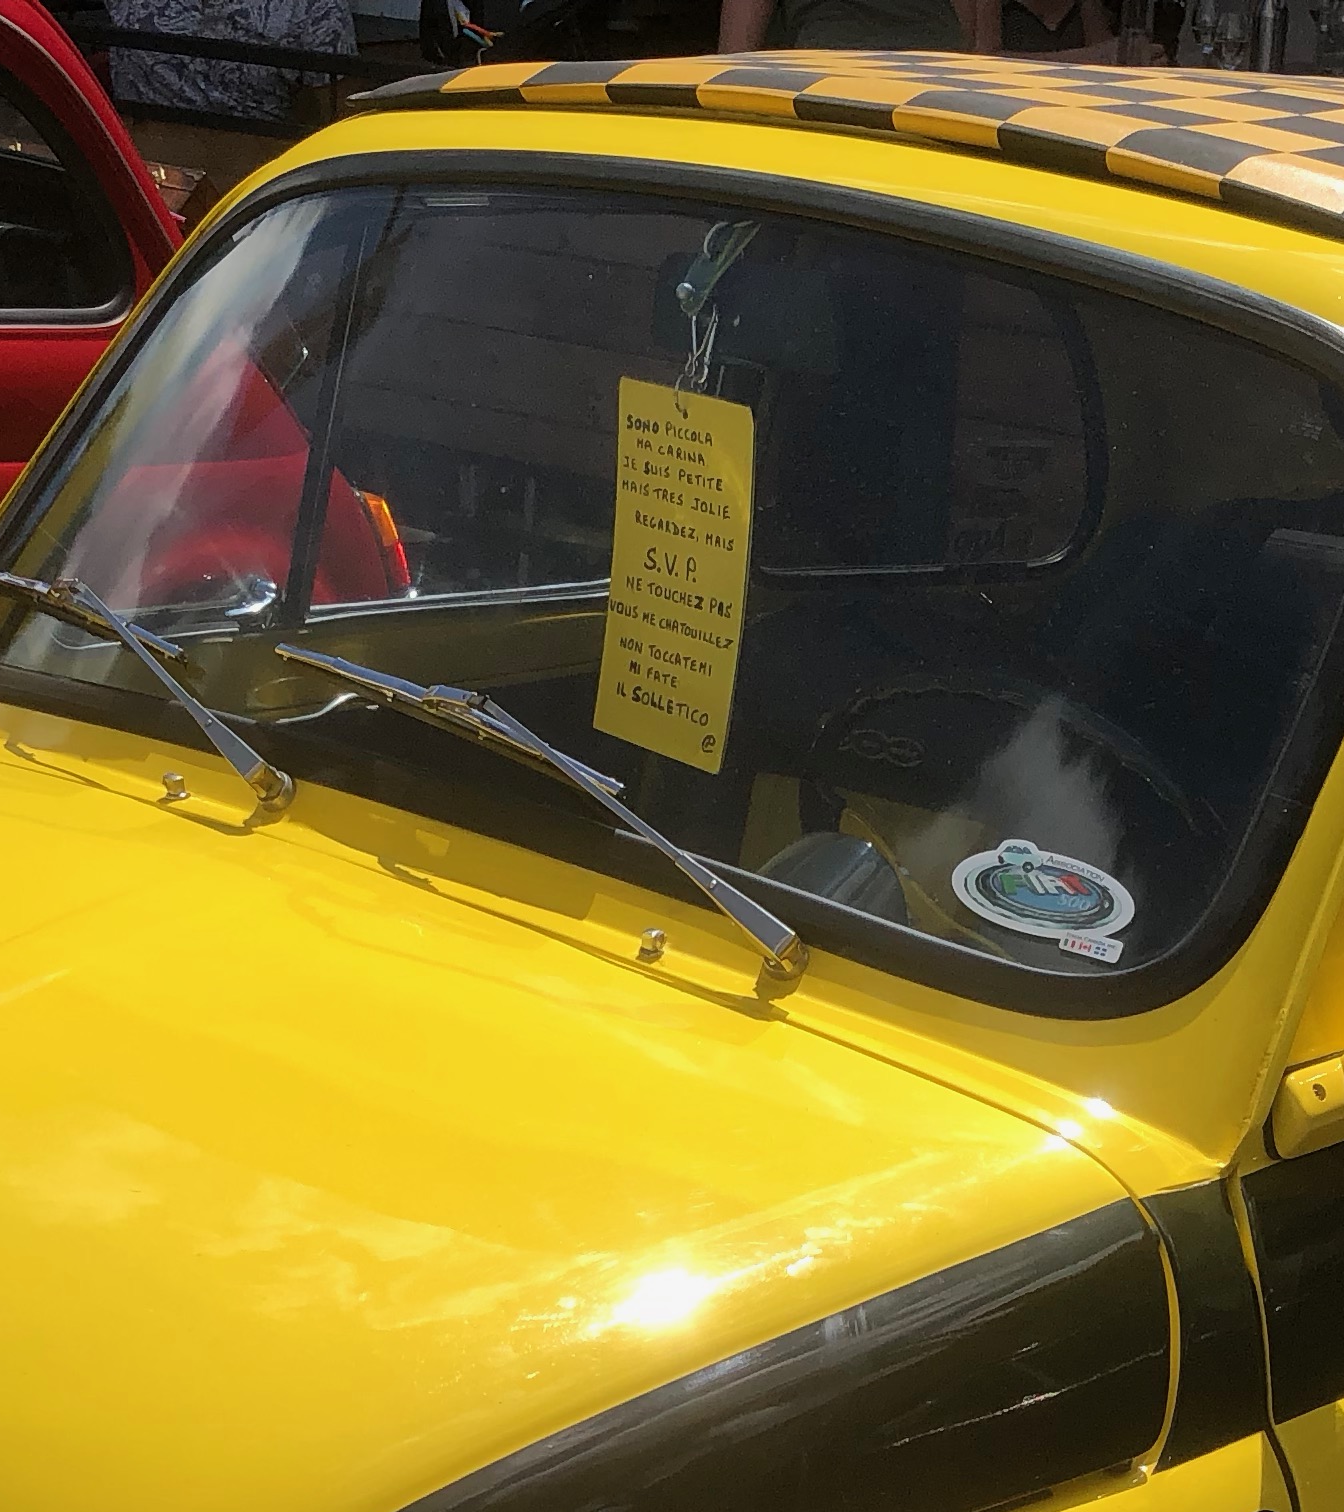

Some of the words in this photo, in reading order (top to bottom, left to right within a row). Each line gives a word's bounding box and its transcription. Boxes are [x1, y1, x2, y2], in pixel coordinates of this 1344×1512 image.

[626, 414, 659, 434] SONO
[665, 421, 713, 446] PICCOLA
[636, 438, 653, 452] MA
[658, 444, 705, 466] CARINA
[623, 456, 637, 470] JE
[643, 461, 670, 478] SUIS
[678, 469, 723, 491] PETITE
[622, 480, 650, 496] MAIS
[653, 488, 683, 506] TRES
[691, 498, 731, 520] JOLIE
[706, 533, 734, 551] MAIS
[626, 576, 643, 592] NE
[647, 582, 704, 611] TOUCHEZ
[709, 597, 733, 619] PAS
[609, 600, 638, 619] VOUS
[642, 612, 656, 626] ME
[659, 618, 734, 649] CHATOUILLEZ
[619, 637, 643, 655] NON
[648, 644, 712, 677] TOCCATEMI
[629, 660, 641, 675] MI
[646, 667, 678, 688] FATE
[616, 682, 627, 698] IL
[632, 685, 709, 726] SOLLETICO
[998, 869, 1093, 896] FIAT
[1057, 893, 1091, 911] 500
